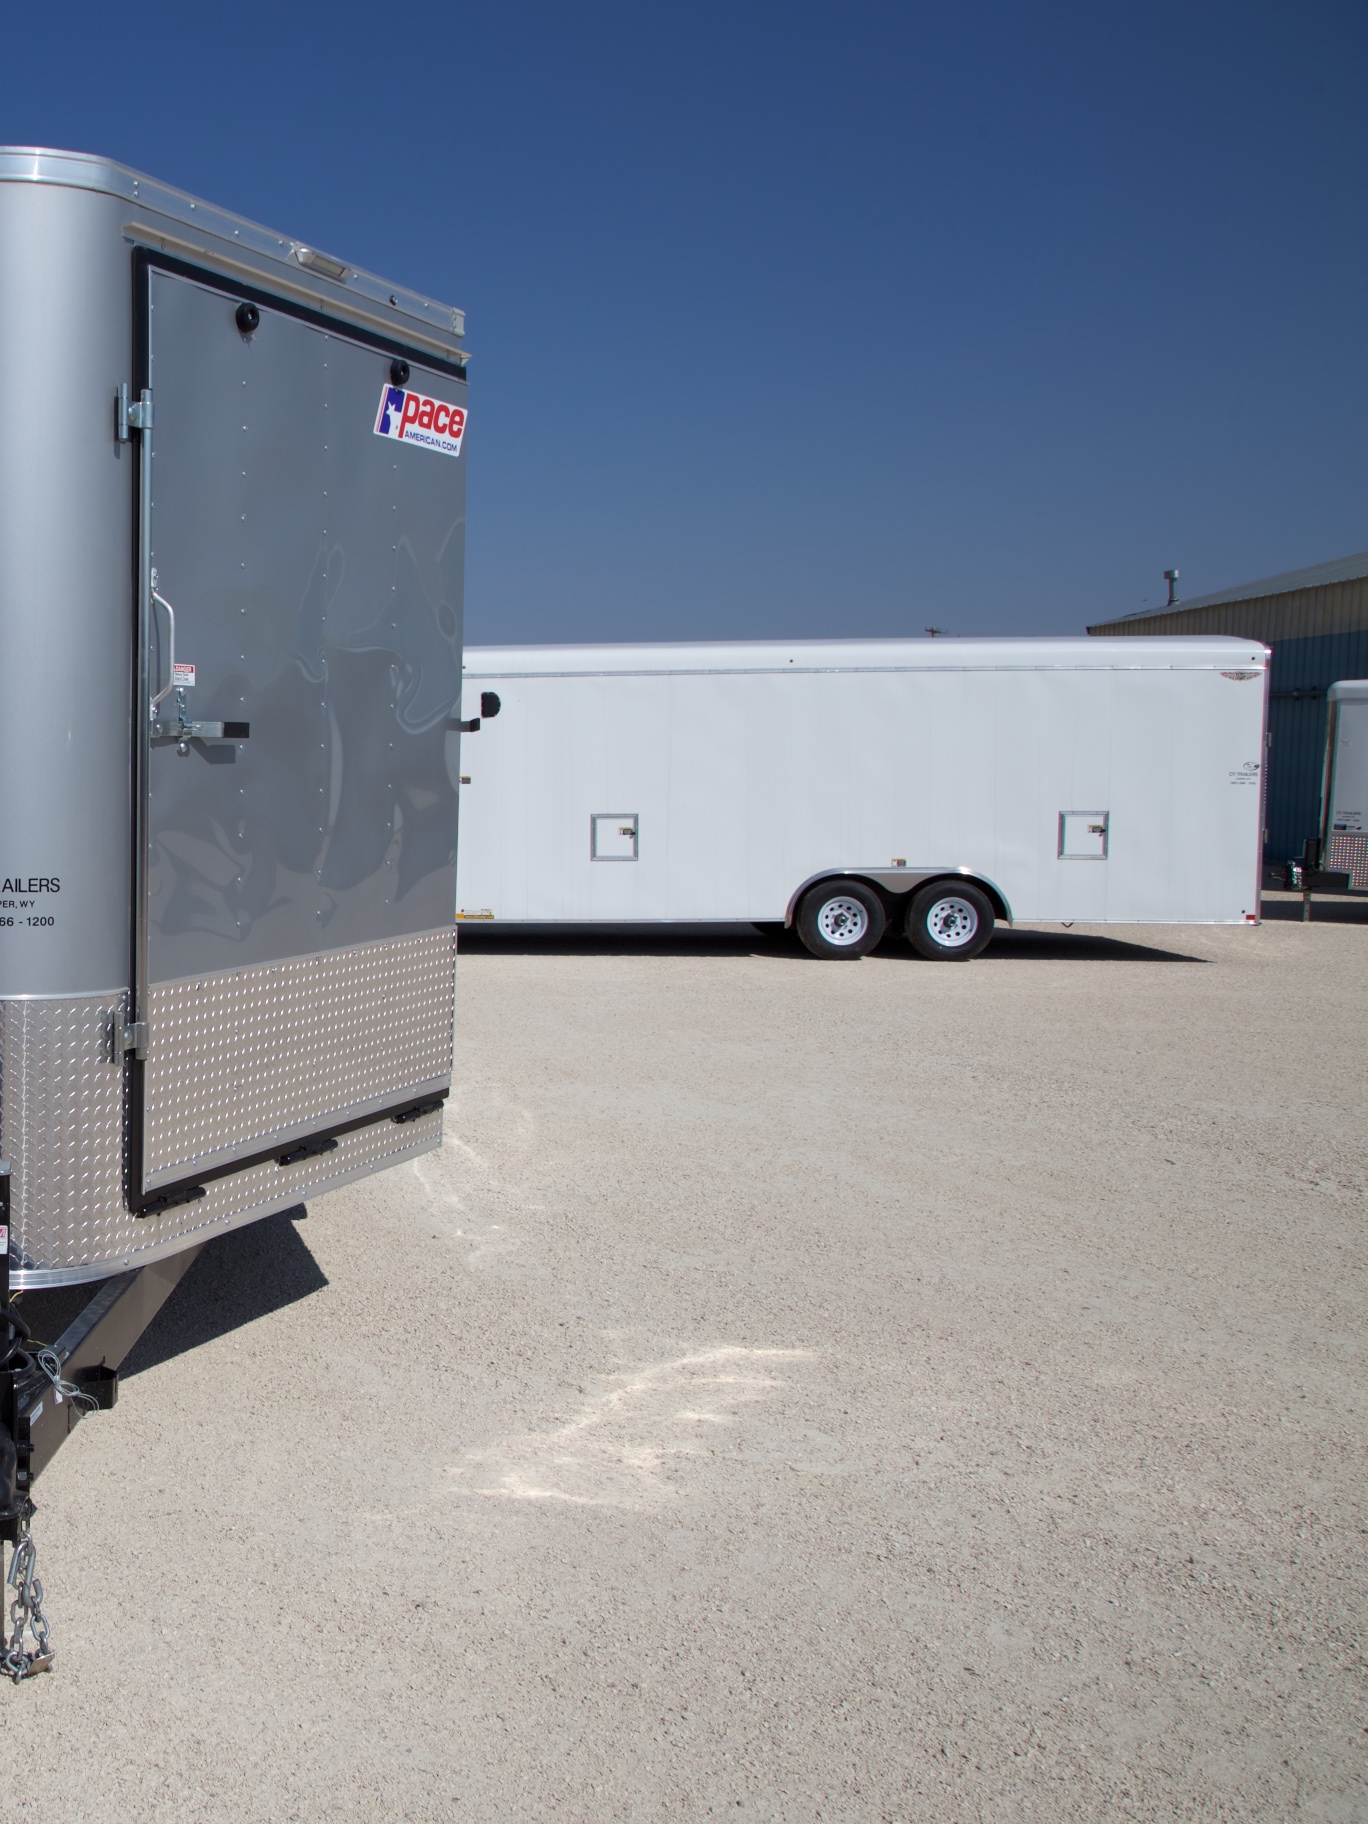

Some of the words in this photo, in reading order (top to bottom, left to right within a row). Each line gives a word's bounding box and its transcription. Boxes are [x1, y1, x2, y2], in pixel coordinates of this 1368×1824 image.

[397, 392, 465, 439] pace
[404, 430, 458, 453] AMERICAN.COM
[19, 900, 36, 908] WY
[26, 916, 55, 927] 1200
